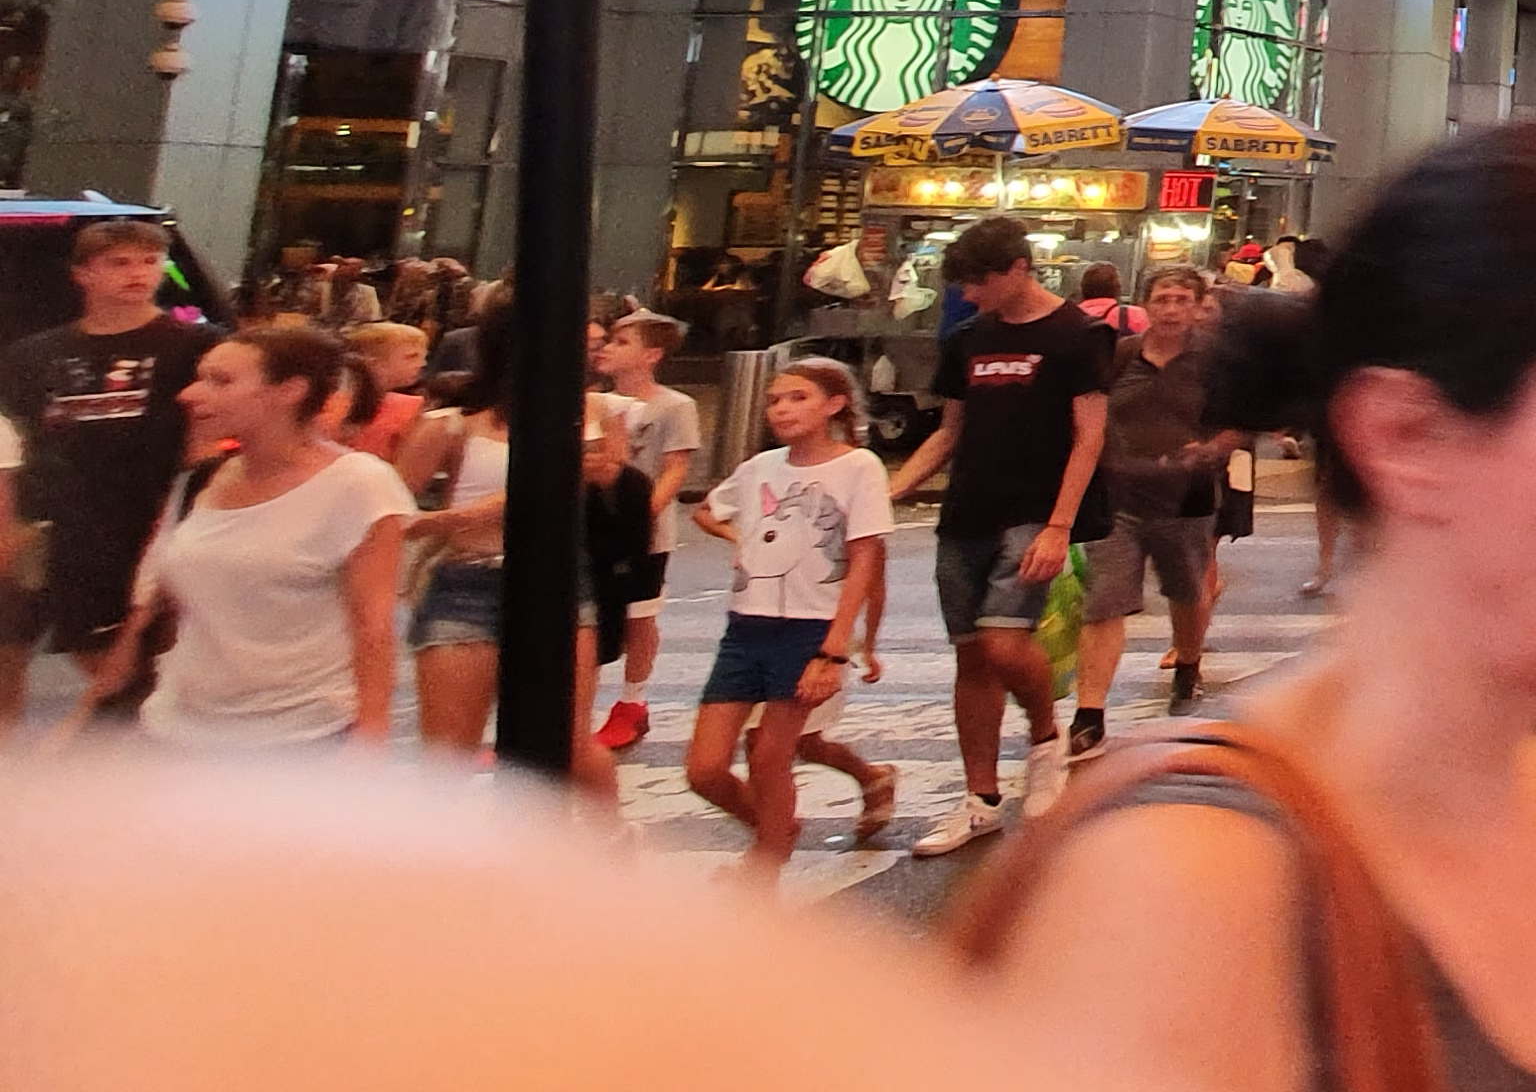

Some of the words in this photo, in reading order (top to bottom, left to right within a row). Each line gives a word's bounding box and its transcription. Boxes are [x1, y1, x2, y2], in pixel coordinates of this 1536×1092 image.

[1029, 124, 1114, 148] SABRETT
[1206, 137, 1299, 155] SABRETT
[1161, 176, 1203, 208] HOT
